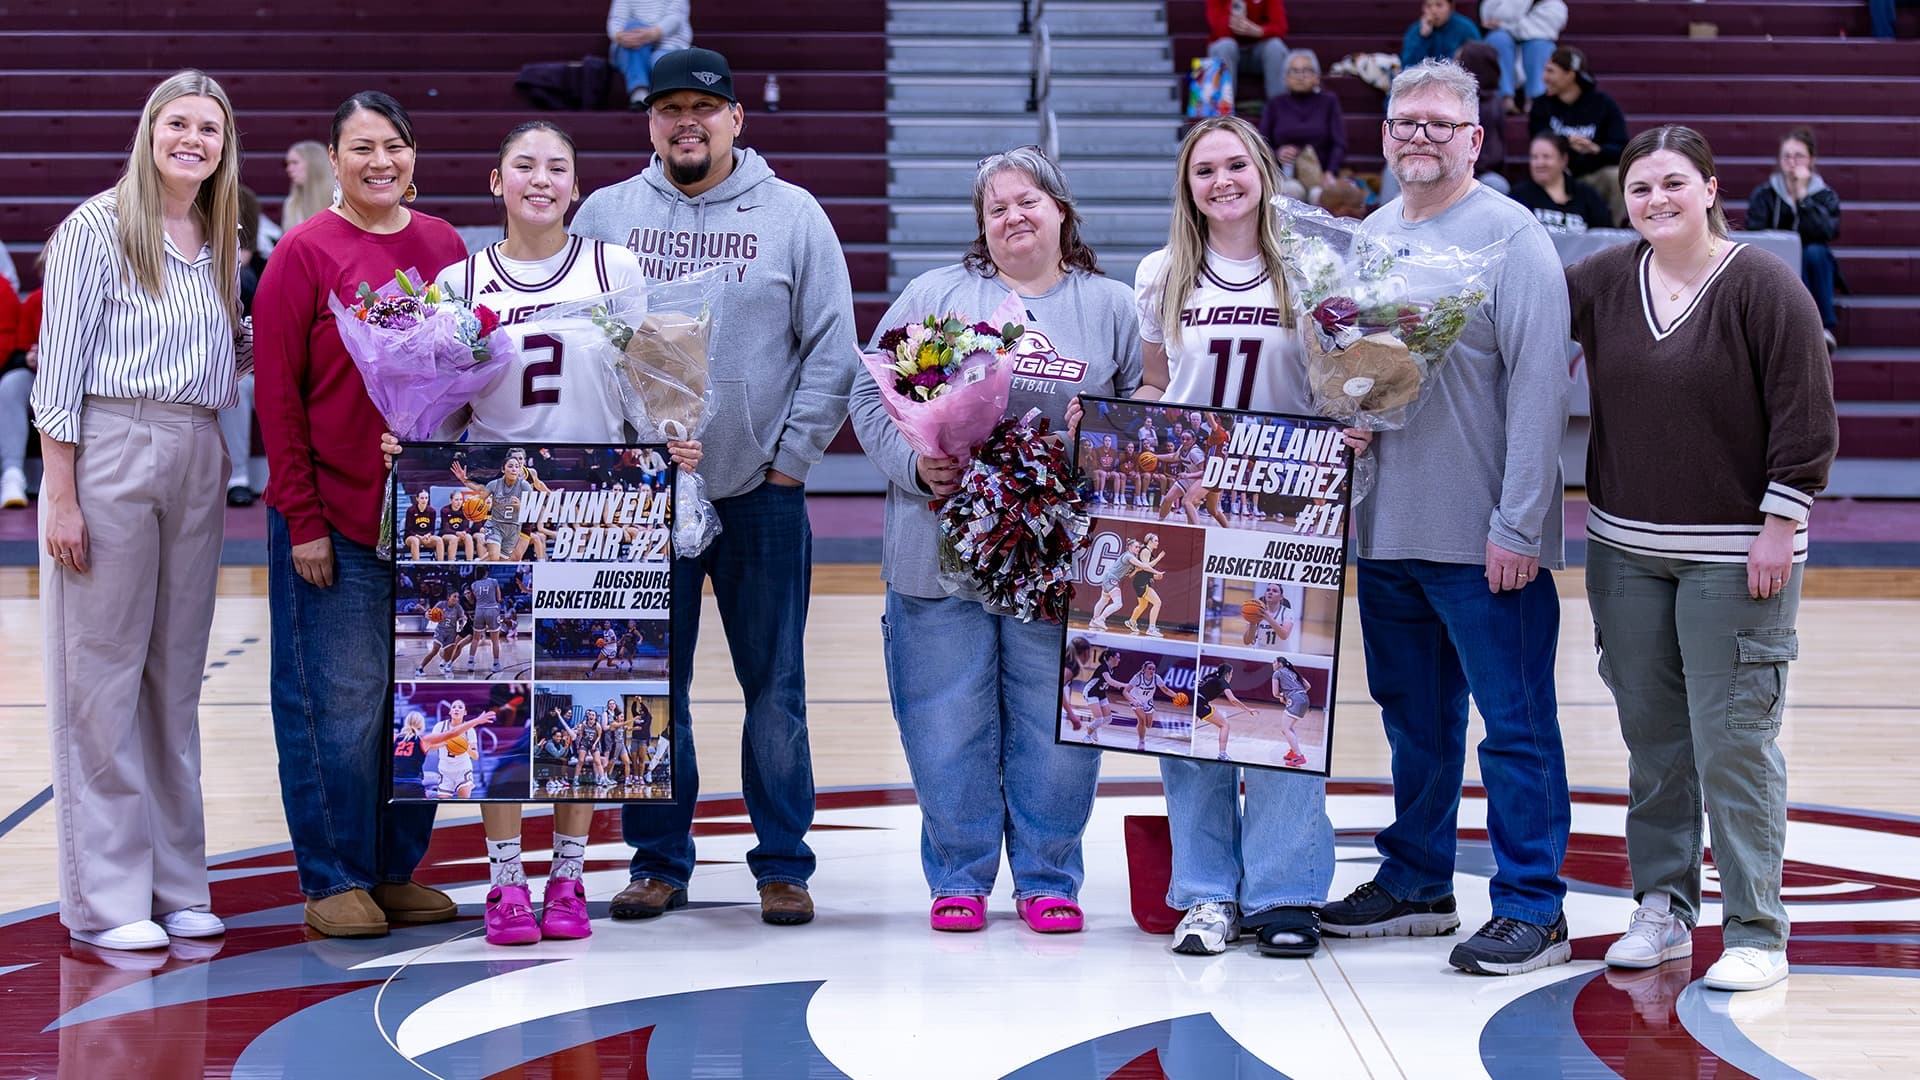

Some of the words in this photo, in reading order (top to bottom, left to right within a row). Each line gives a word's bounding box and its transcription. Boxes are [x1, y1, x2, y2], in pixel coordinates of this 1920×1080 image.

[626, 227, 758, 260] AUGSBURG
[520, 332, 565, 408] 2
[1208, 337, 1264, 410] 11
[1228, 422, 1347, 465] MELANIE
[1201, 456, 1347, 500] DELESTREZ
[519, 491, 667, 524] WAKINYELA
[1293, 503, 1344, 536] #11
[552, 527, 623, 560] BEAR
[628, 528, 670, 560] #2
[1263, 541, 1343, 566] AUGSBURG
[593, 570, 670, 589] AUGSBURG
[1205, 555, 1295, 581] BASKETBALL
[1299, 565, 1341, 586] 2026
[535, 590, 626, 609] BASKETBALL
[630, 591, 670, 610] 2026
[395, 741, 414, 757] 23
